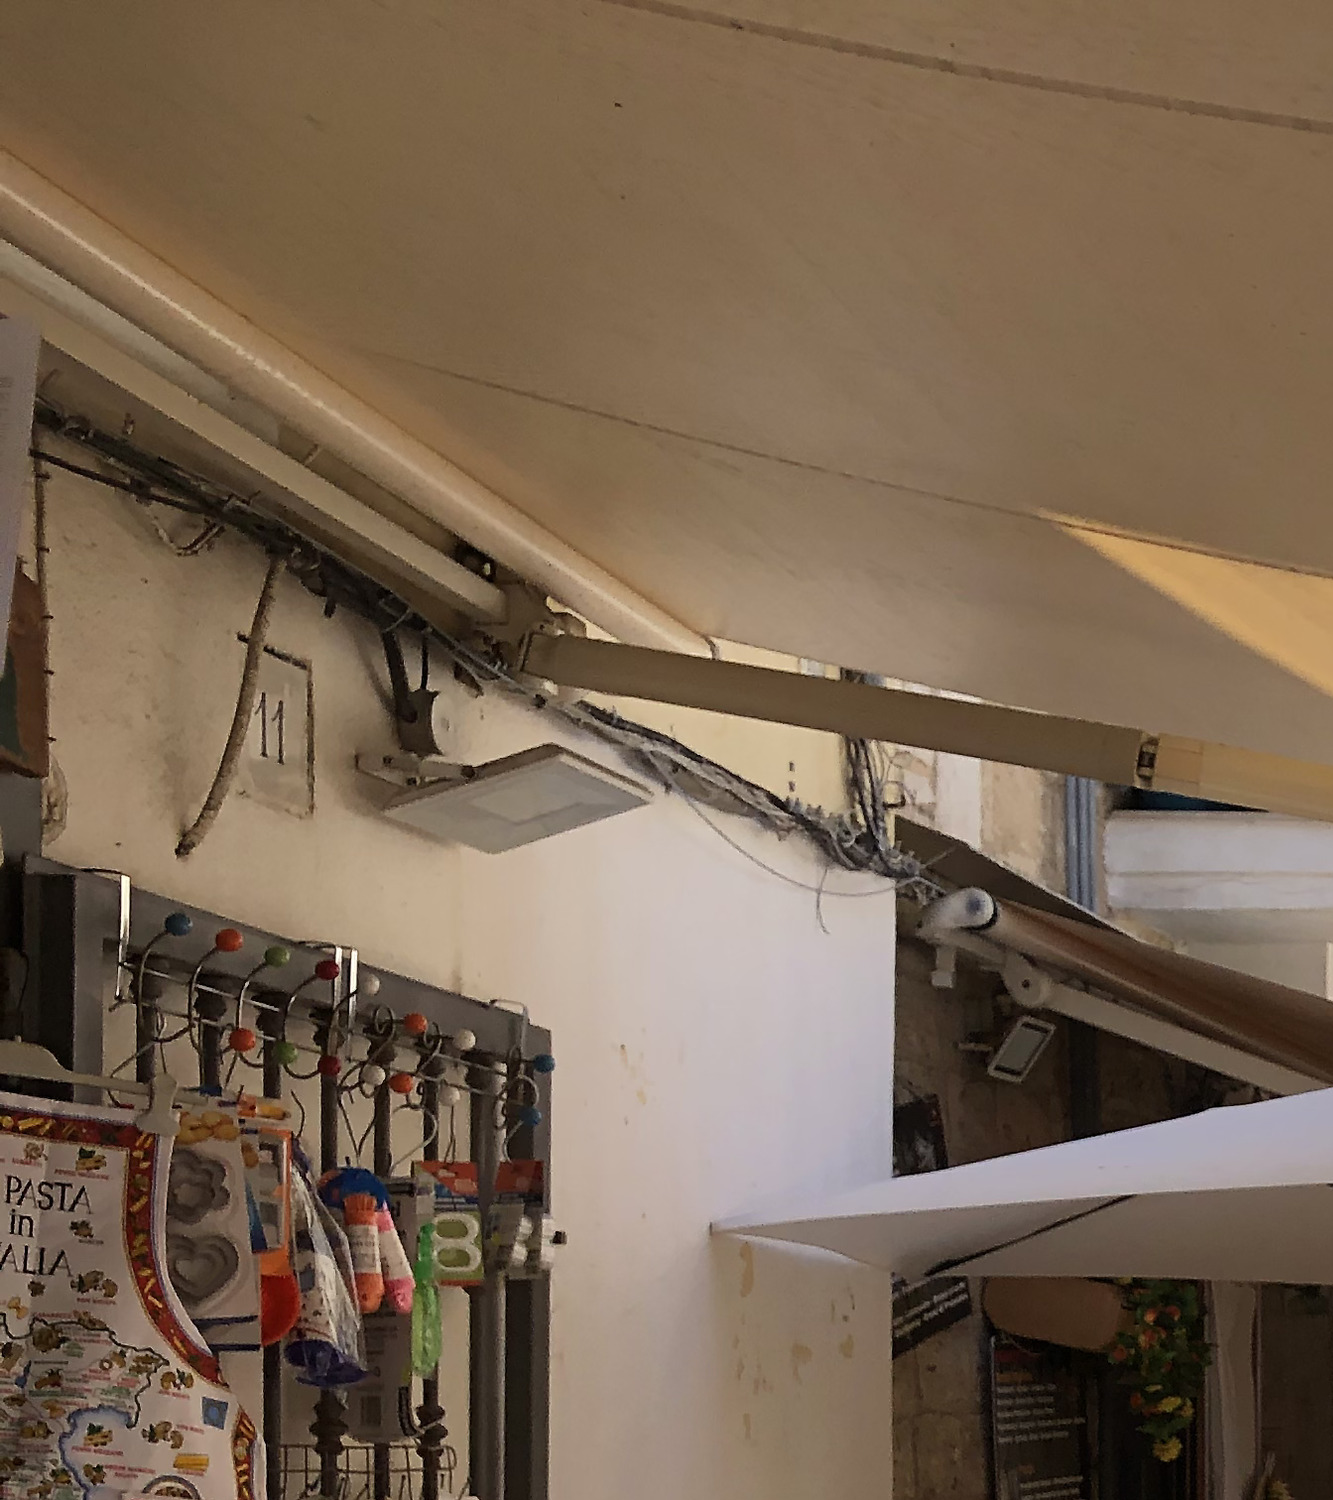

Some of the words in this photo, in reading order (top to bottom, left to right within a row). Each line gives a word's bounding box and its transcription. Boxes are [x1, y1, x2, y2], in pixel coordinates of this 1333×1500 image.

[254, 692, 285, 764] 11
[5, 1174, 92, 1214] PASTA
[9, 1211, 34, 1238] in
[0, 1242, 73, 1277] ALIA
